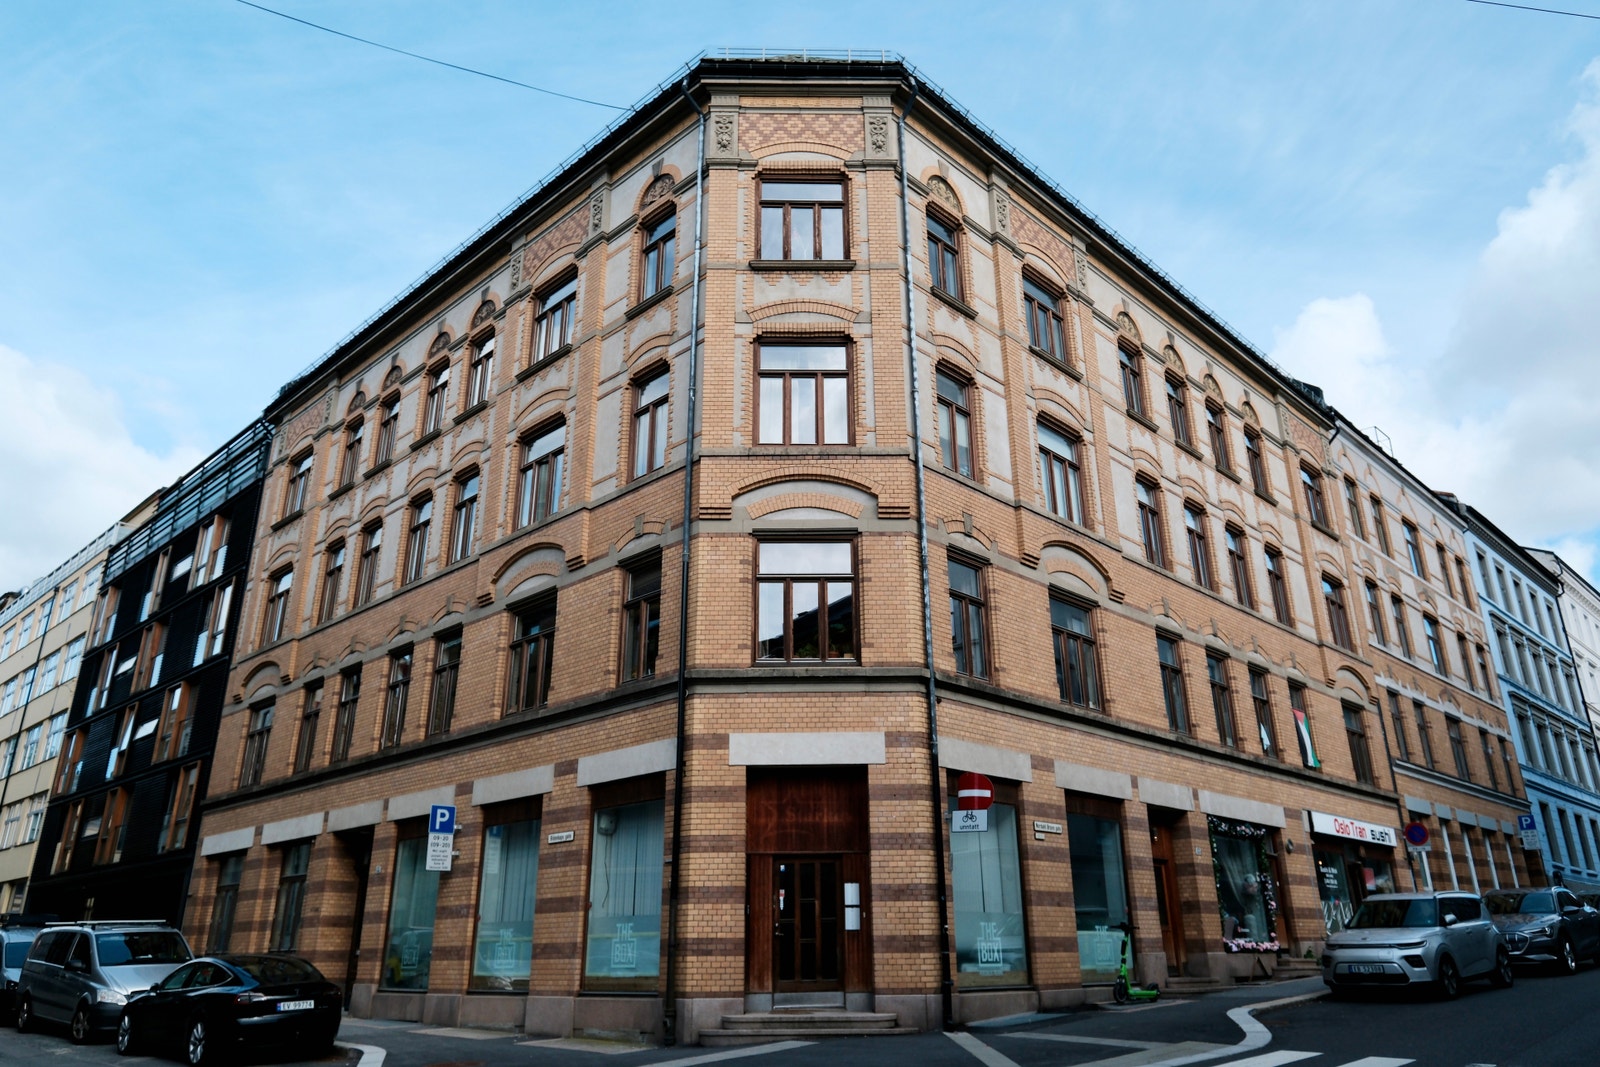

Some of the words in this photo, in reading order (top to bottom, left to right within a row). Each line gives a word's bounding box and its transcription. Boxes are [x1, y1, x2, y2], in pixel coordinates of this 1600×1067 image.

[435, 808, 450, 830] P
[959, 823, 980, 831] unntatt
[1521, 816, 1531, 829] P
[1334, 818, 1350, 835] Oslo
[1350, 821, 1367, 839] Tran
[1370, 828, 1392, 843] sushi
[616, 923, 634, 941] THE
[980, 922, 997, 940] THE
[614, 943, 634, 963] BOX
[981, 942, 999, 962] BOX
